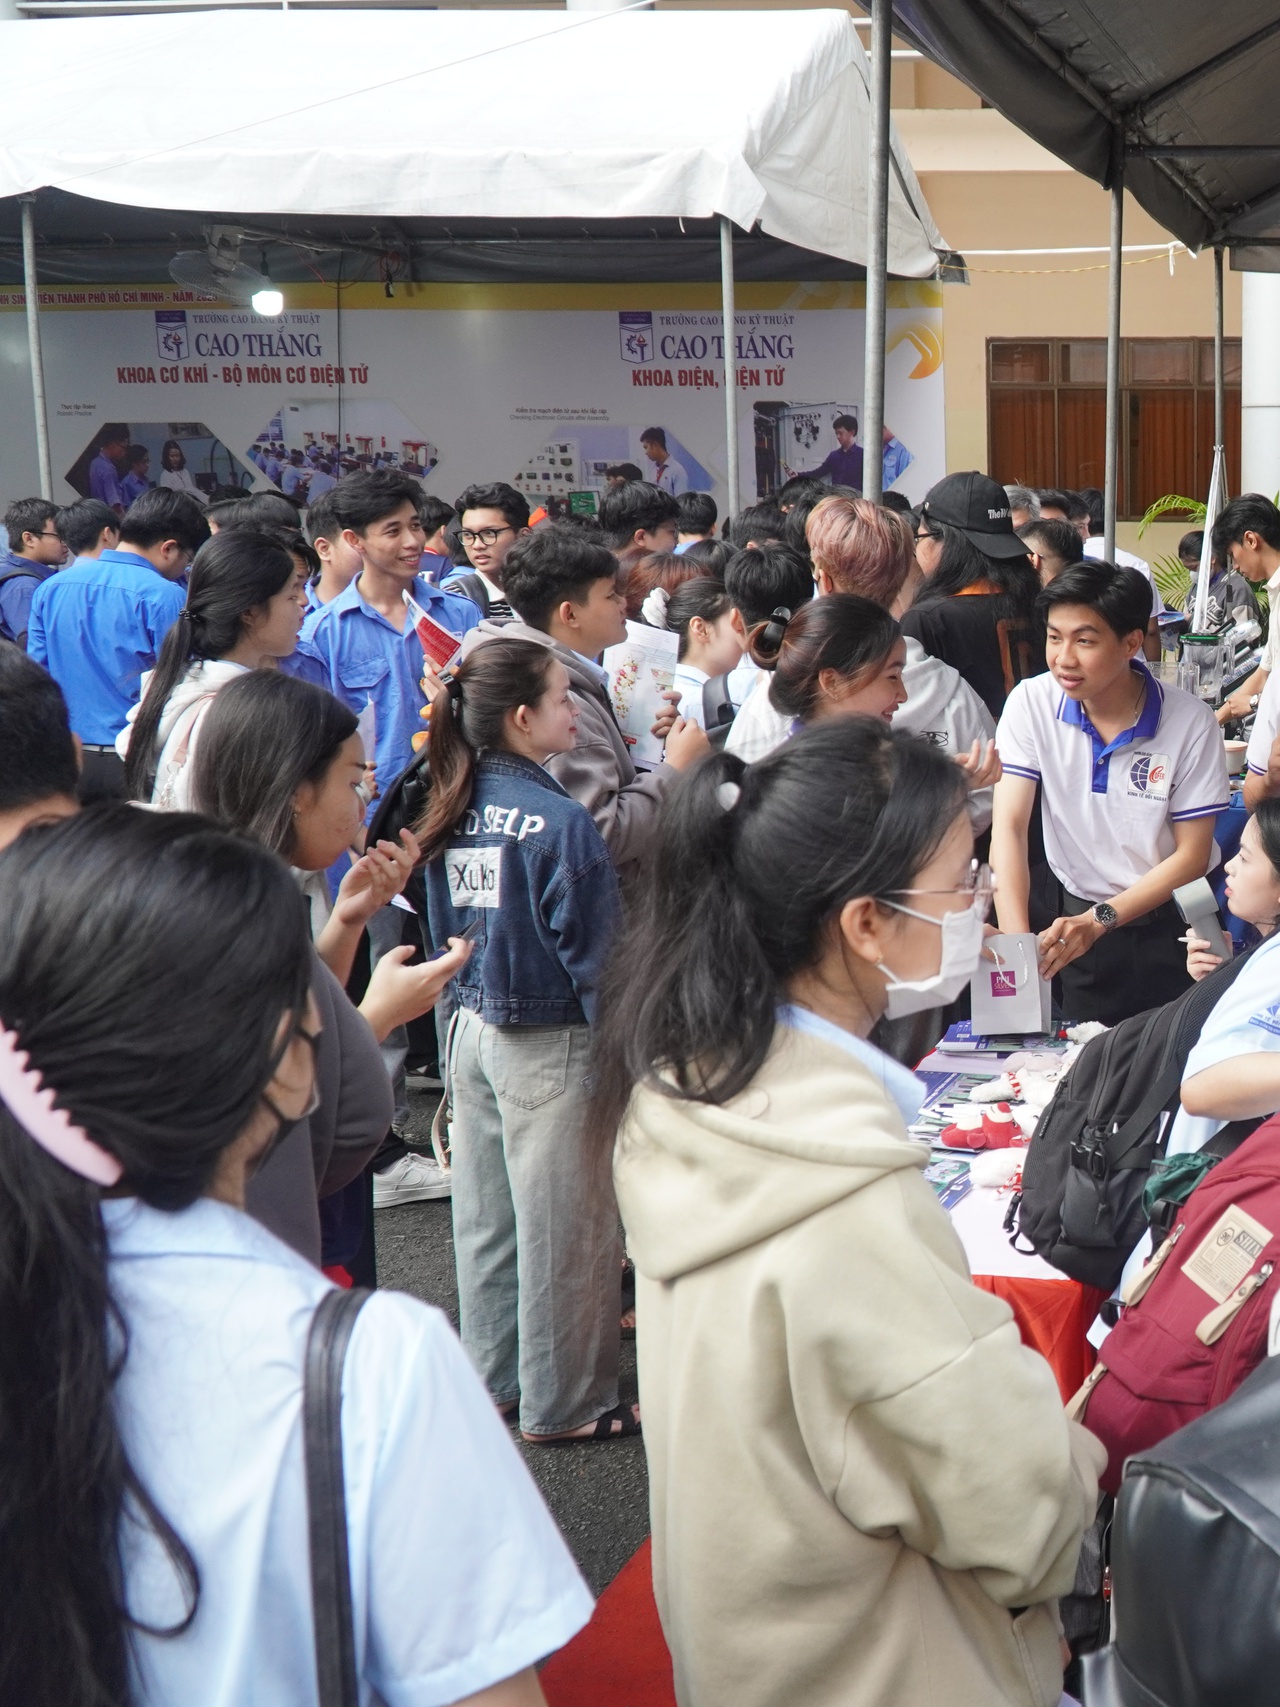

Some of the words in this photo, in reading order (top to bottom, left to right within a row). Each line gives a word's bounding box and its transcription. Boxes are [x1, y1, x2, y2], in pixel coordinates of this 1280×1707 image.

[38, 292, 54, 304] IÊN
[57, 292, 86, 304] THÀNH
[88, 289, 106, 303] PHỐ
[123, 290, 138, 302] CHÍ
[140, 292, 164, 302] MINH
[172, 290, 193, 302] NĂM
[192, 312, 228, 324] TRƯỜNG
[231, 314, 248, 324] CAO
[291, 312, 320, 325] THUẬT
[659, 313, 697, 325] TRƯỜNG
[700, 316, 718, 325] CAO
[764, 313, 794, 326] THUẬT
[195, 333, 240, 356] CAO
[243, 326, 322, 356] THẮNG
[660, 335, 707, 359] CAO
[117, 366, 156, 384] KHOA
[160, 365, 179, 384] CƠ
[183, 363, 208, 384] KHÍ
[222, 363, 242, 386] BỘ
[247, 363, 282, 384] MÔN
[286, 366, 306, 384] CƠ
[310, 364, 345, 387] ĐIỆN
[349, 362, 369, 384] TỬ
[632, 369, 674, 386] KHOA
[678, 366, 718, 390] ĐIỆN,
[724, 366, 760, 390] IỆN
[764, 364, 785, 386] TỬ
